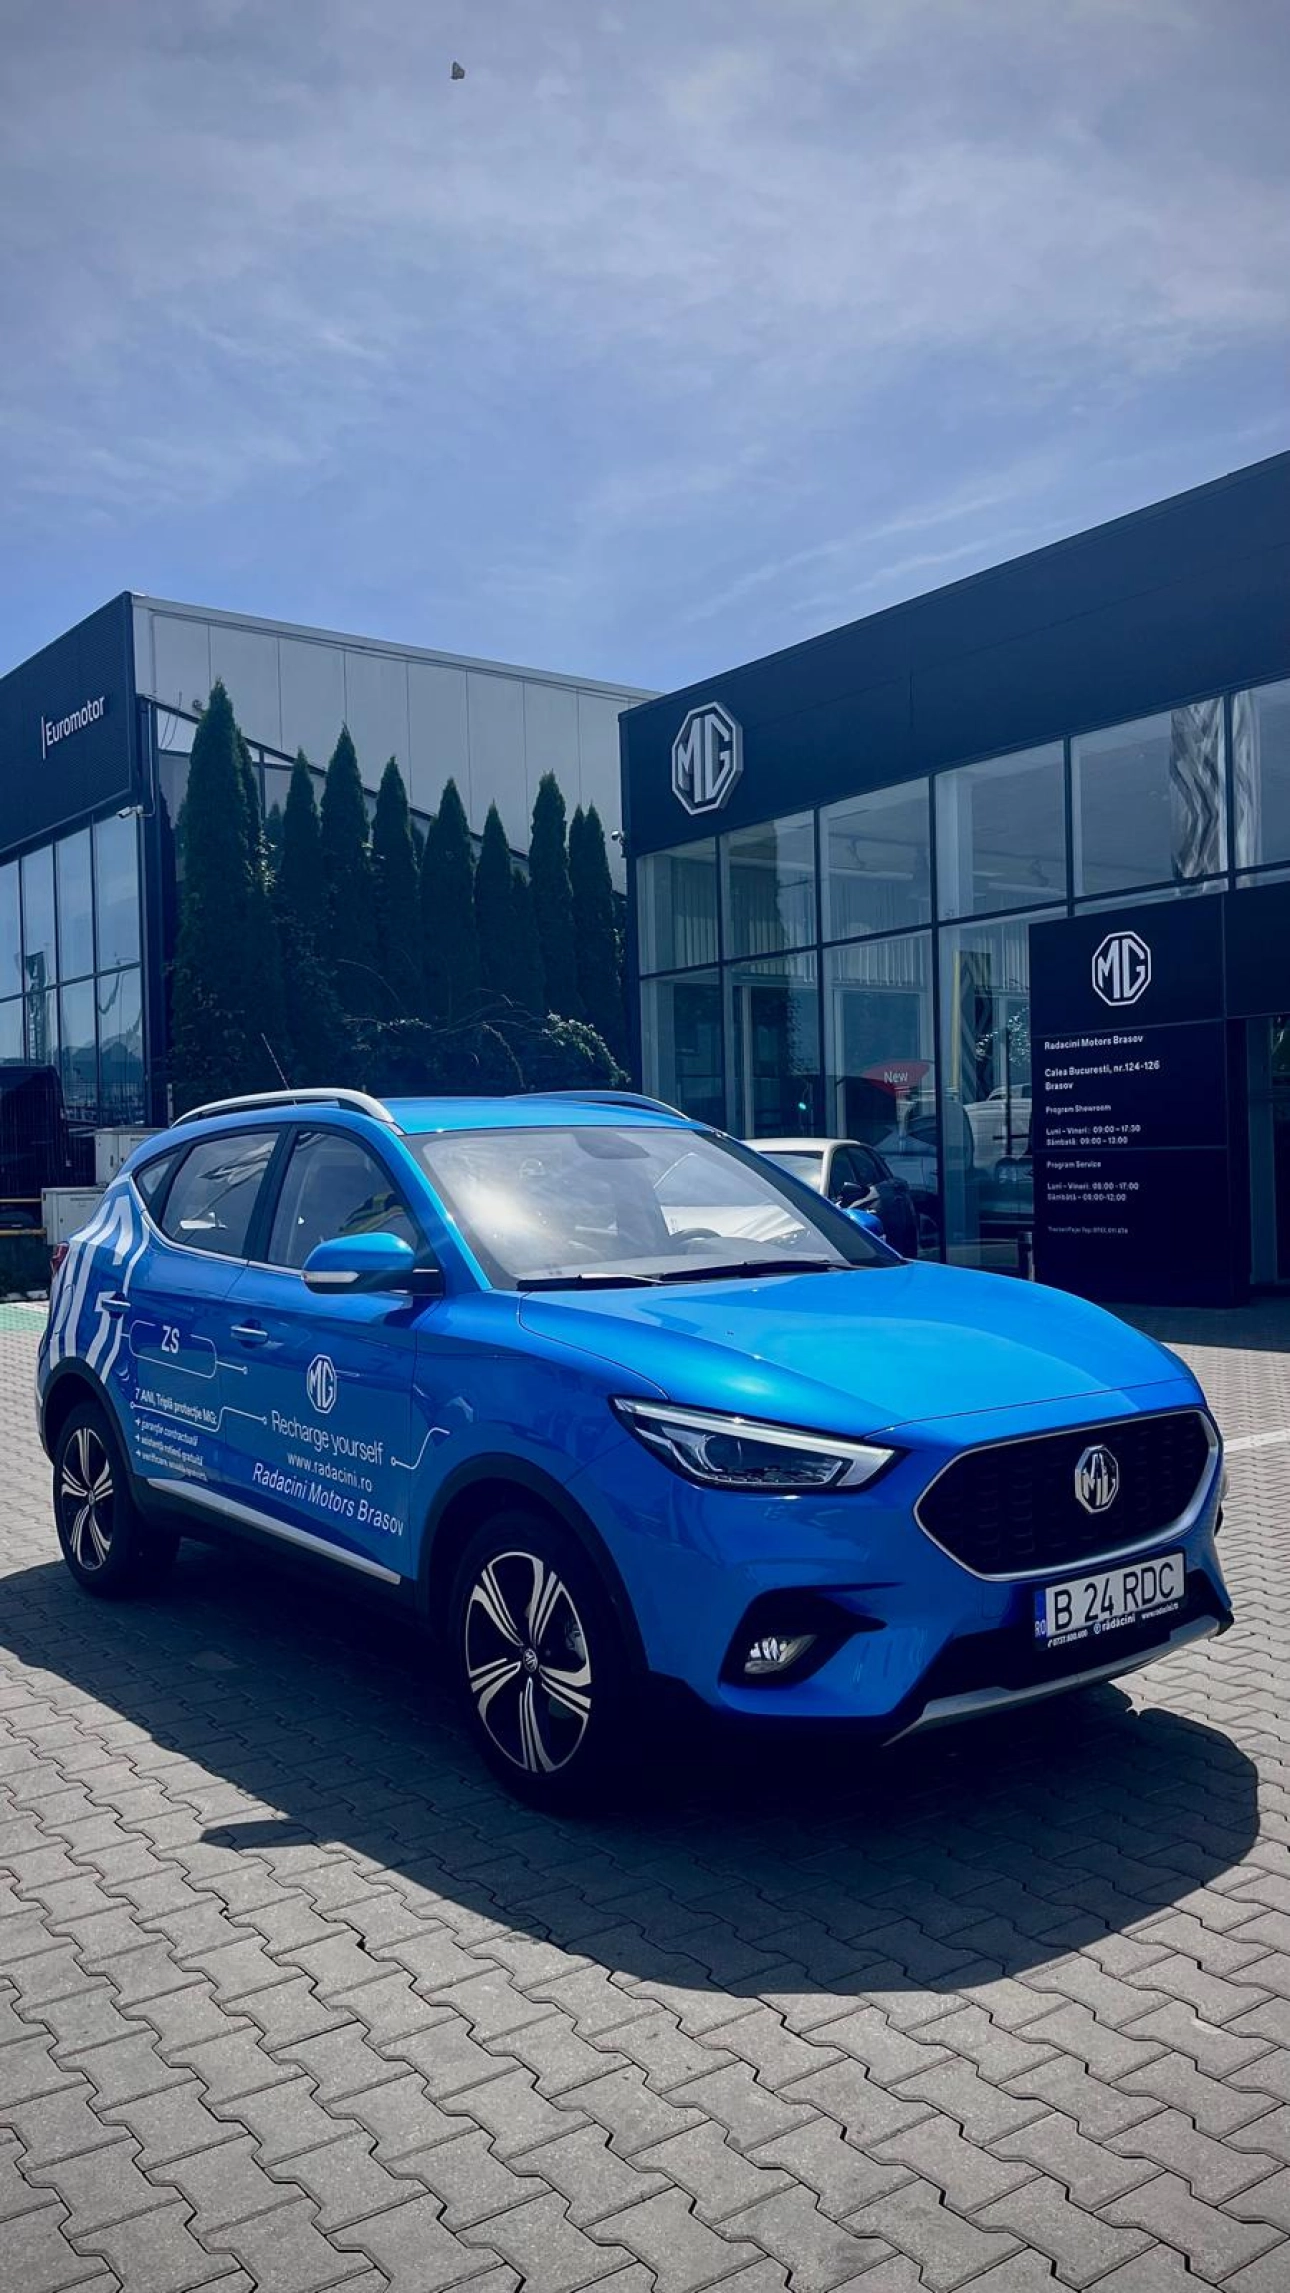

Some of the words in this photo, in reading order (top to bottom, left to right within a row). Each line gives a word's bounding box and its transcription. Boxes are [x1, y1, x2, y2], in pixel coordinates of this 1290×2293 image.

[45, 696, 104, 746] Euromotor
[676, 712, 732, 804] MG
[1096, 937, 1147, 1000] MG
[1044, 1038, 1080, 1050] Radacini
[1081, 1037, 1112, 1047] Motors
[1113, 1035, 1144, 1044] Brasov
[883, 1071, 908, 1084] New
[1044, 1068, 1068, 1077] Calea
[1044, 1082, 1074, 1091] Brasov
[161, 1325, 180, 1354] ZS
[135, 1387, 141, 1400] 7
[308, 1359, 335, 1410] MG
[271, 1410, 329, 1453] Recharge
[331, 1433, 384, 1466] yourself
[287, 1452, 373, 1493] www.radacini.ro
[1080, 1451, 1117, 1508] MG
[252, 1462, 308, 1500] Radacini
[307, 1481, 355, 1518] Motors
[357, 1498, 404, 1537] Brasov
[1054, 1589, 1072, 1632] B
[1084, 1577, 1114, 1623] 24
[1123, 1562, 1175, 1612] RDC
[1034, 1619, 1047, 1638] RO
